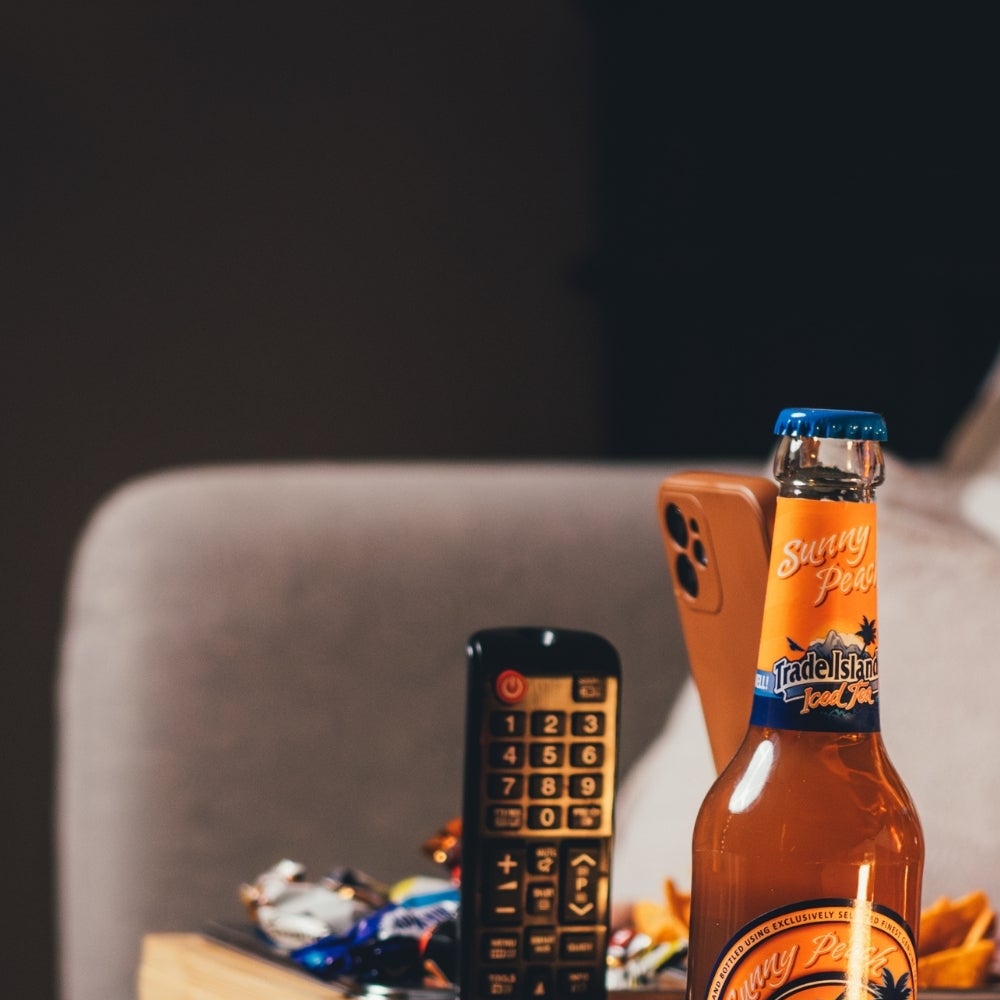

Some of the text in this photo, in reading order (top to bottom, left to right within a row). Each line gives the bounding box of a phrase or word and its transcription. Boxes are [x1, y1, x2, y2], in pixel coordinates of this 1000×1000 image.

[777, 525, 871, 579] Sunny
[800, 681, 848, 714] Iced
[505, 714, 599, 734] 1 2 3
[502, 745, 597, 765] 4 5 6
[502, 777, 596, 797] 7 8 9
[539, 807, 555, 828] 0
[575, 877, 588, 891] P
[712, 981, 722, 1000] AND
[719, 946, 744, 979] BOTTLED
[744, 926, 770, 946] USING
[772, 911, 834, 930] EXCLUSIVELY
[838, 911, 880, 924] SELED
[881, 920, 902, 938] FINEST
[804, 930, 898, 978] Peh
